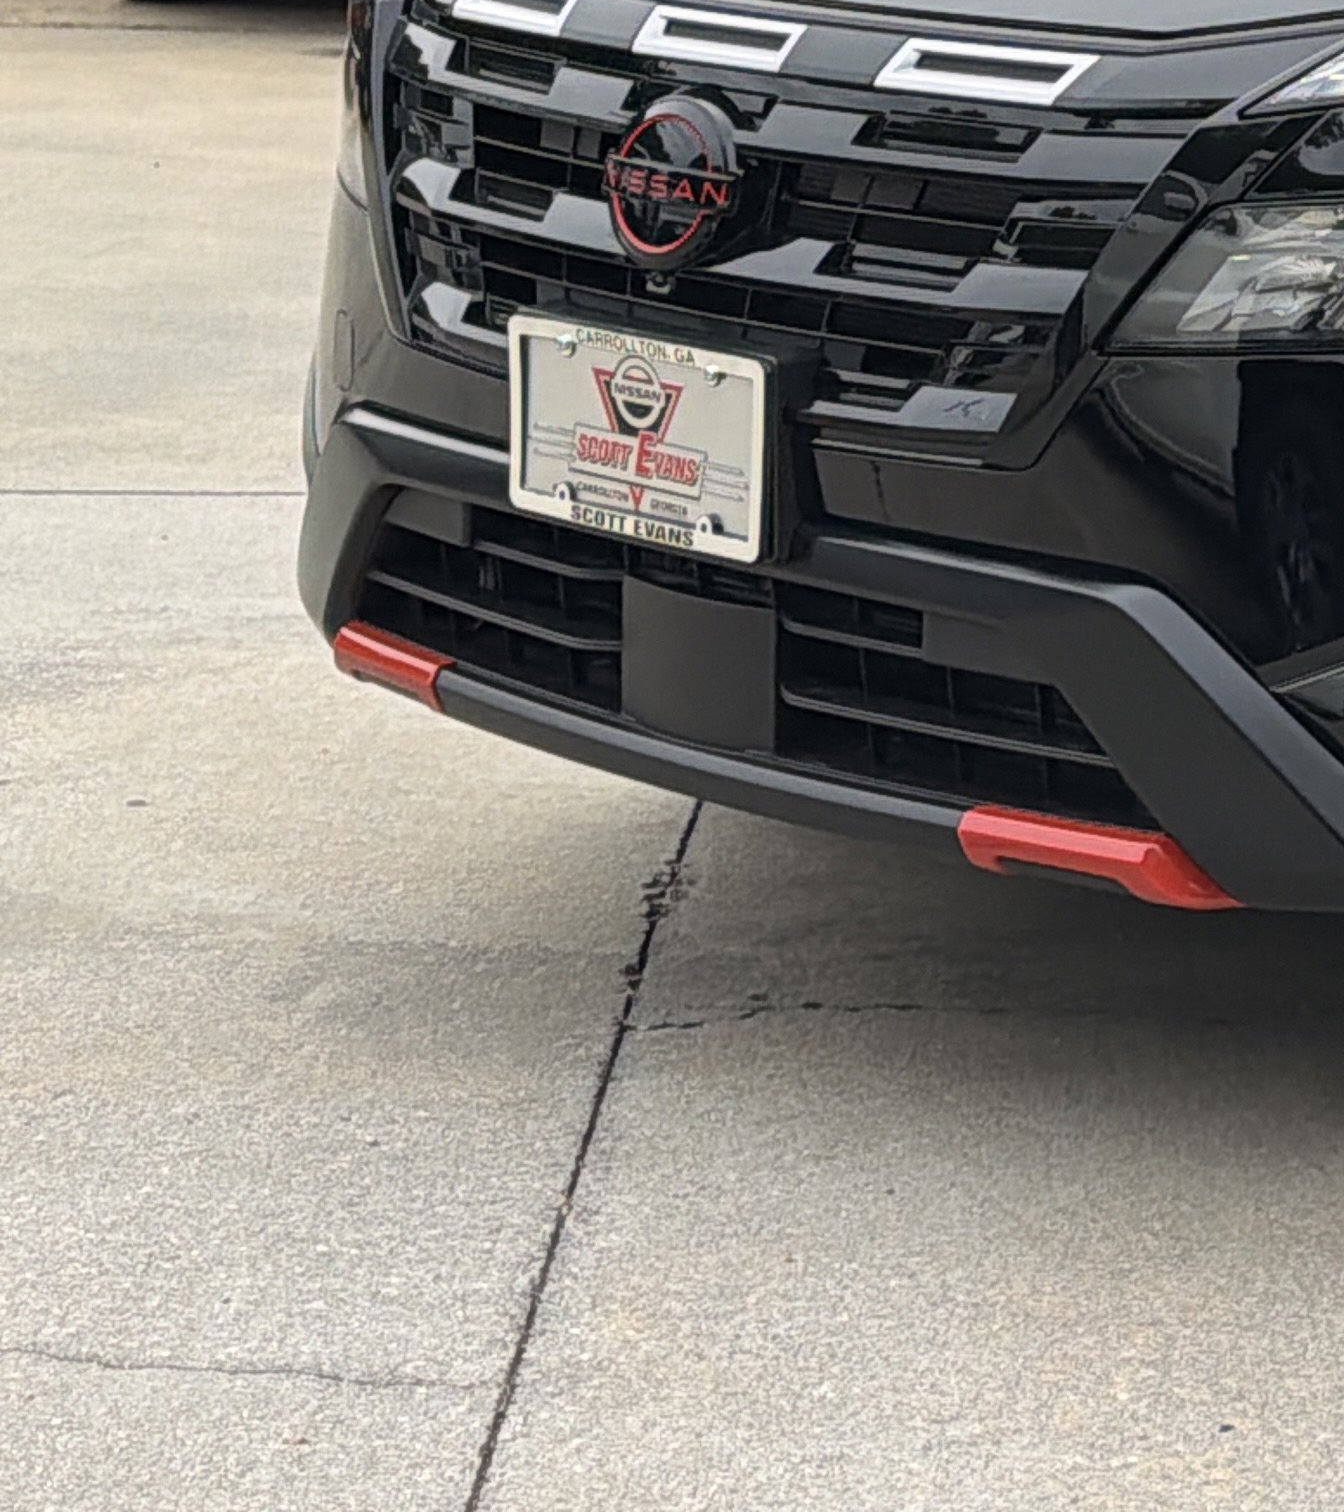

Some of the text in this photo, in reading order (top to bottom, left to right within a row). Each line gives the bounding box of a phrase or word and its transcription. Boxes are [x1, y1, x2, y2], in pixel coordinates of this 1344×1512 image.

[673, 346, 696, 367] GA
[613, 382, 662, 403] NISSAN
[577, 431, 700, 487] SCOTT EVANS
[570, 505, 695, 548] SCOTT EVANS
